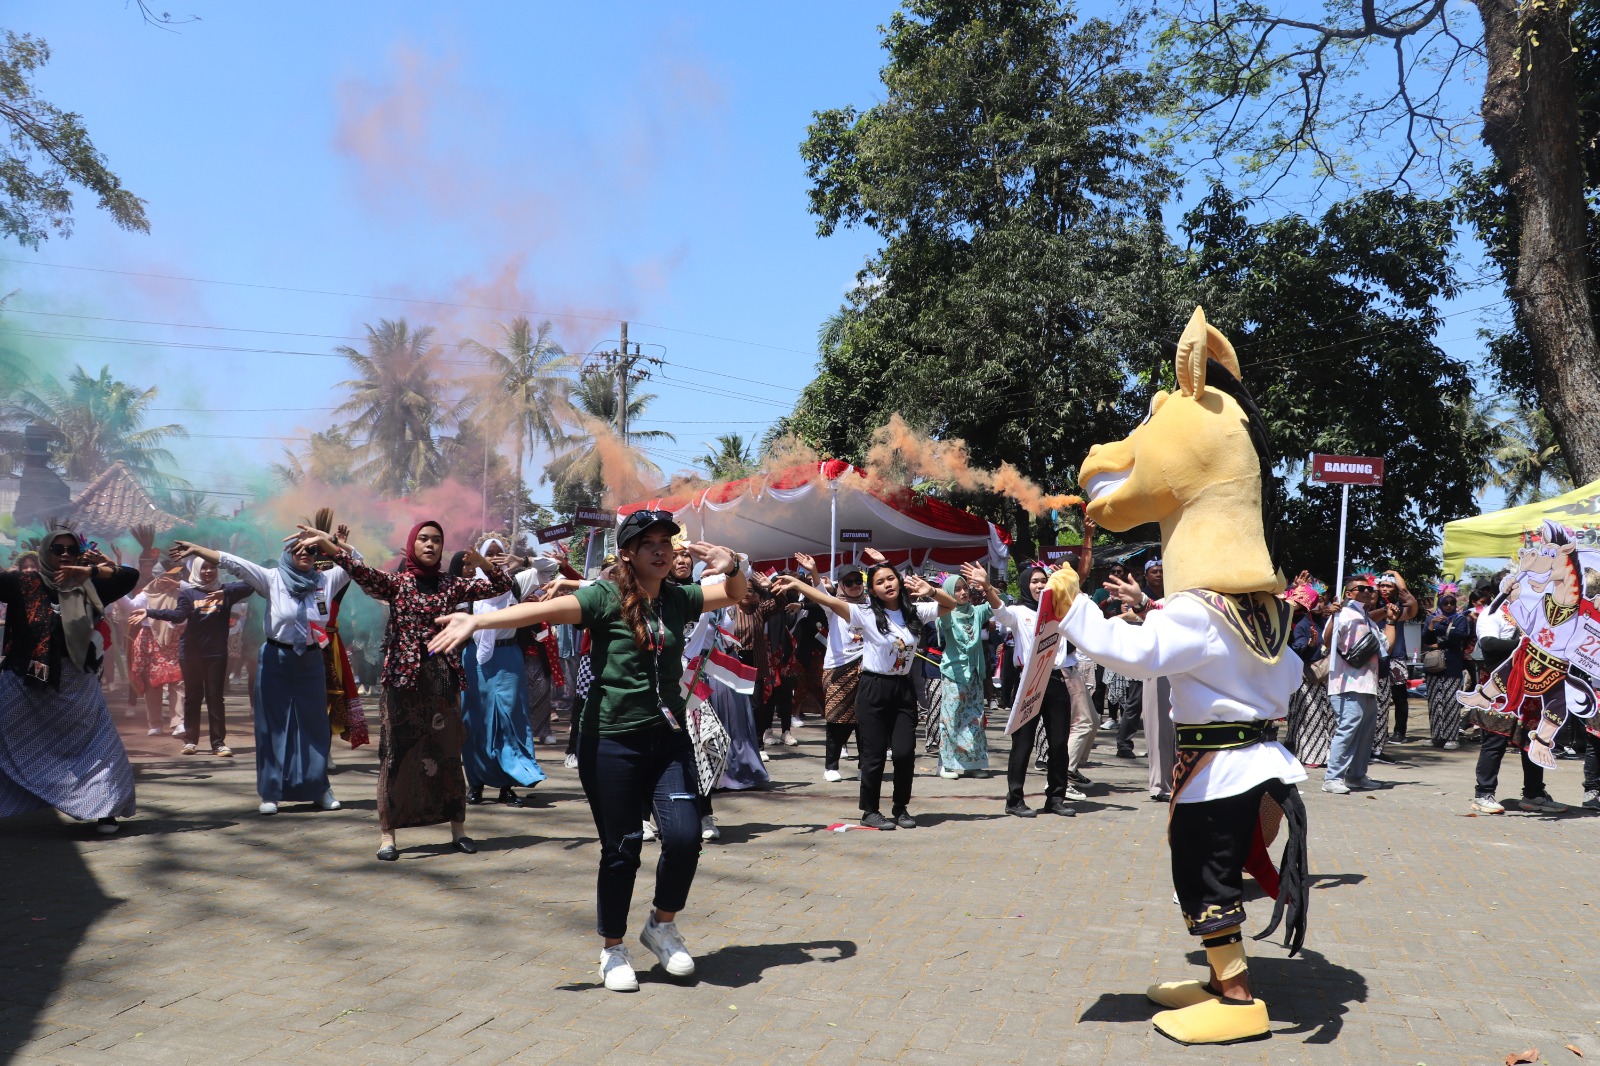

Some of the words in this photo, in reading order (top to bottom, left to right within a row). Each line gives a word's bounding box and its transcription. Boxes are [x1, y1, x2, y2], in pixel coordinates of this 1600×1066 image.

[1324, 462, 1373, 474] BAKUNG
[578, 511, 614, 522] KANIGORO
[544, 527, 567, 537] WLINGI
[1578, 658, 1593, 669] 2024
[1026, 649, 1054, 696] 27
